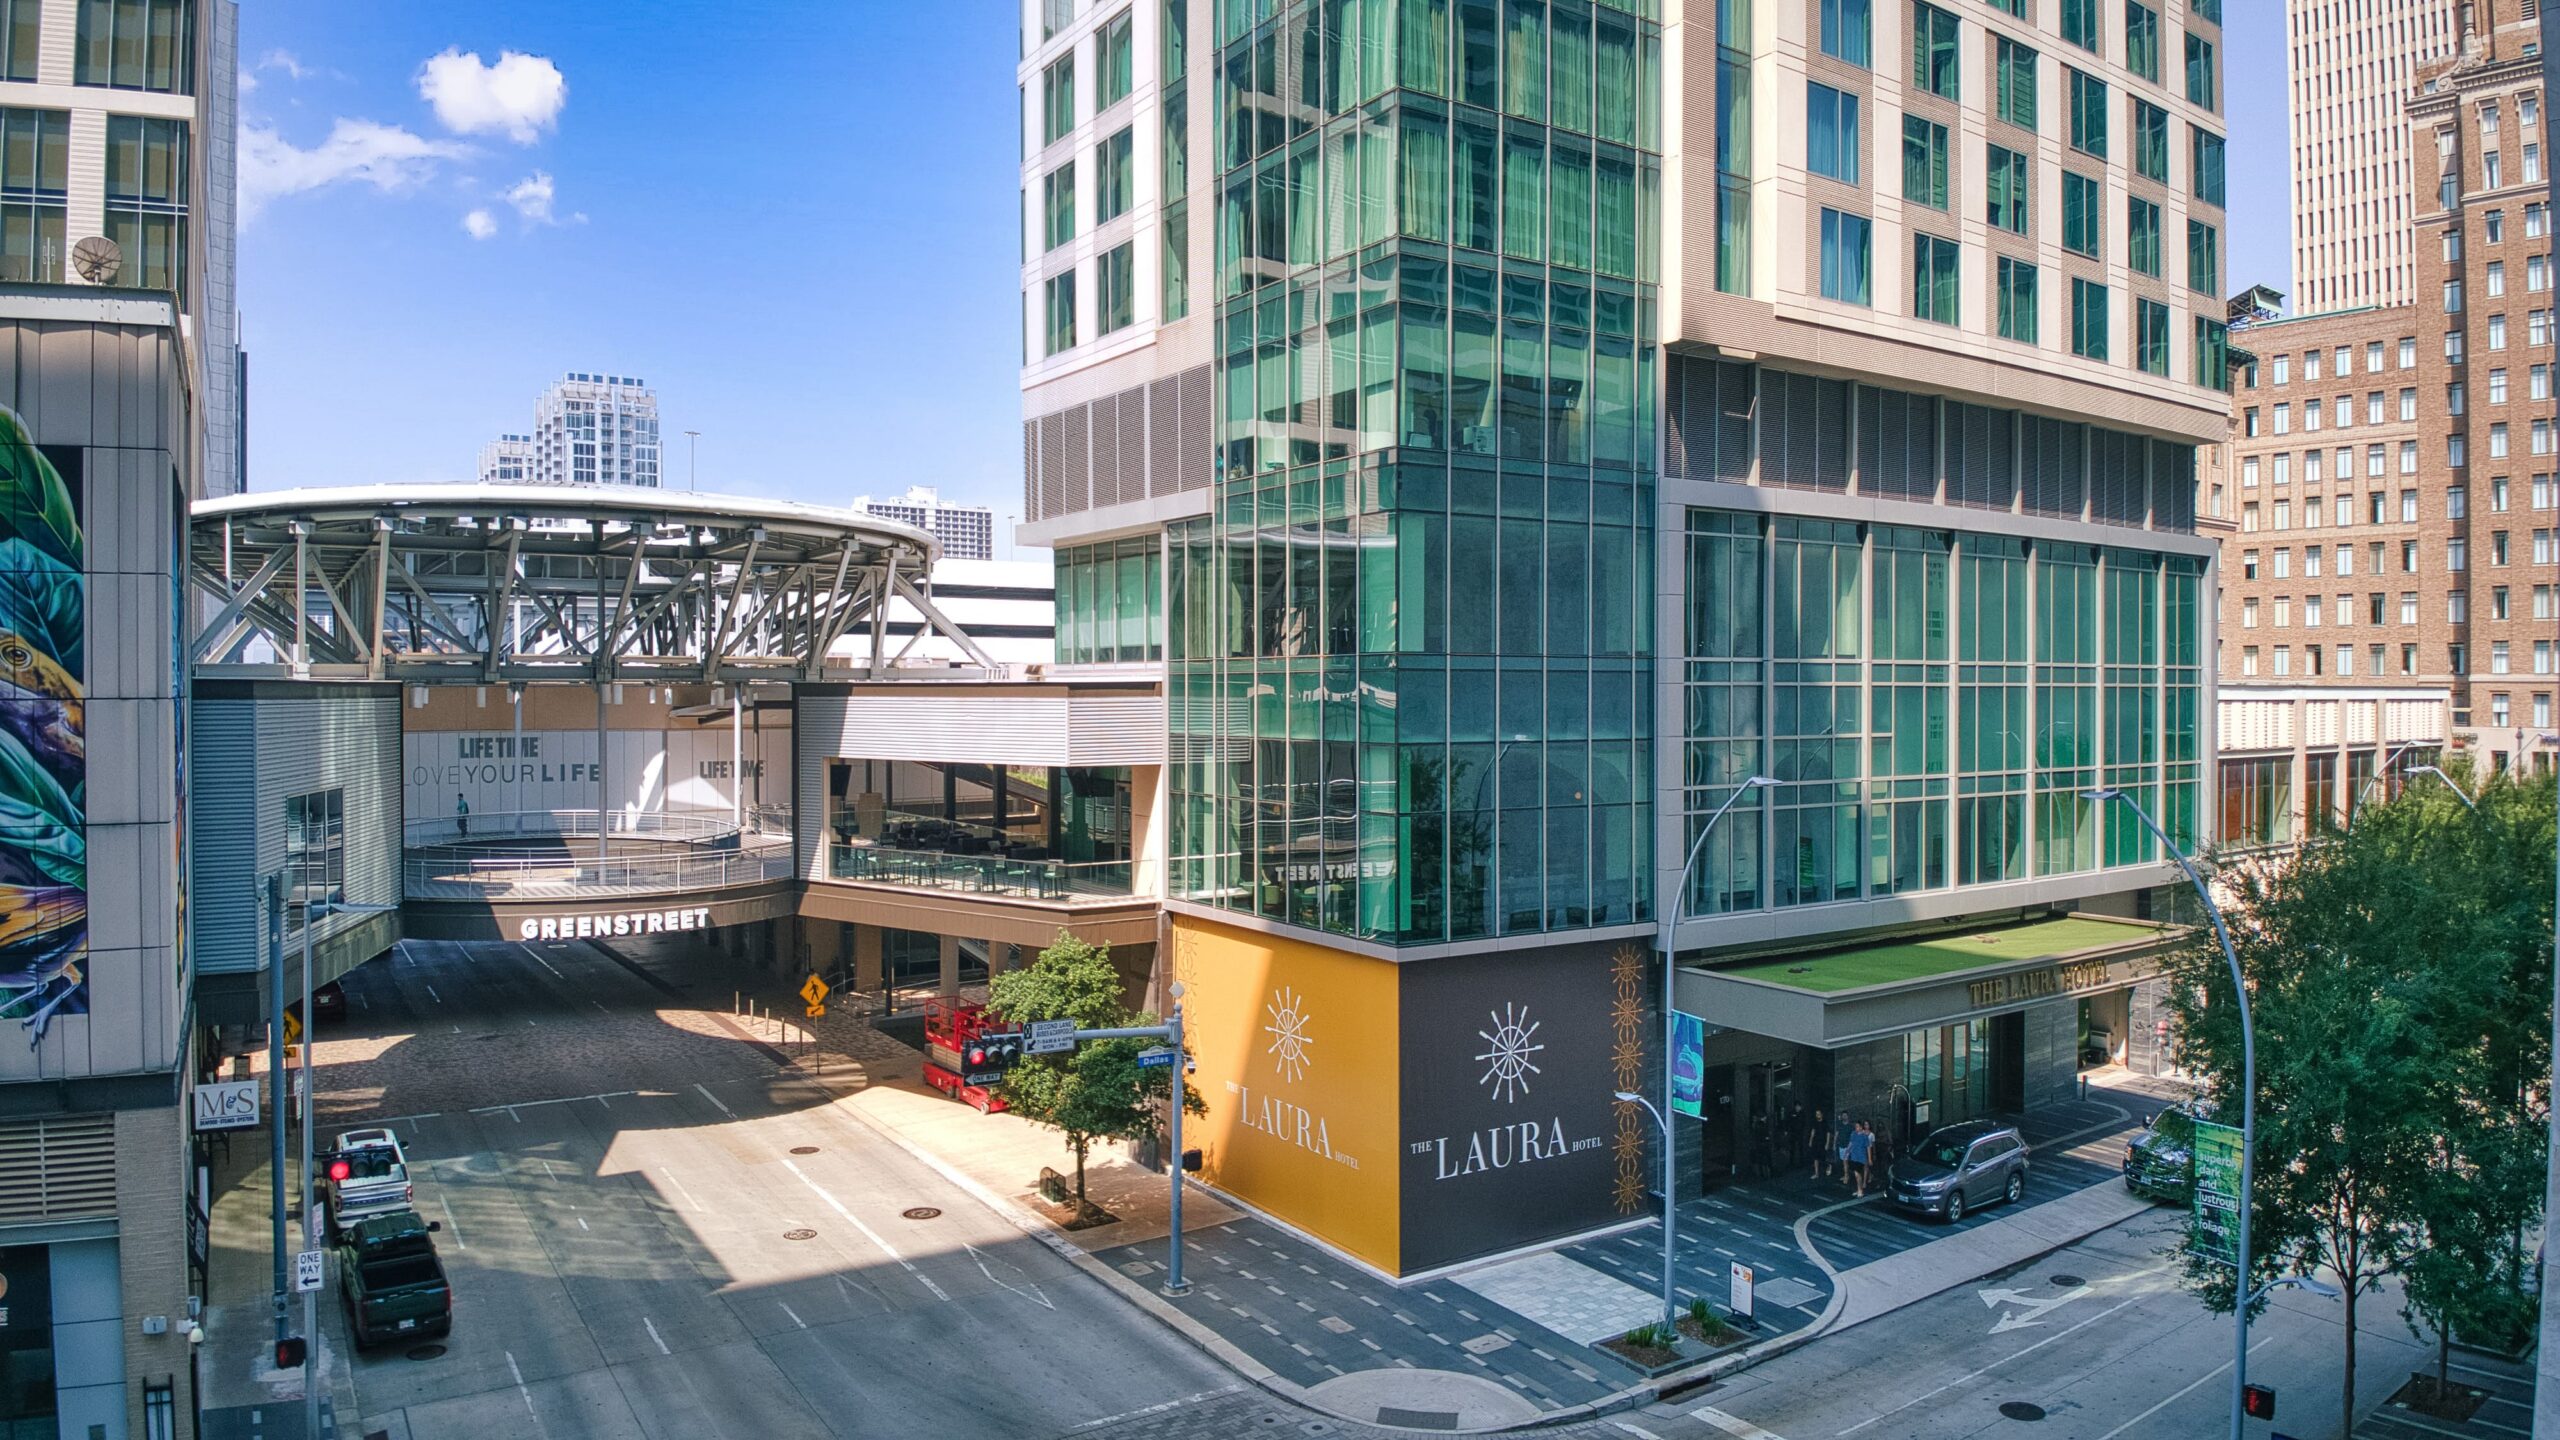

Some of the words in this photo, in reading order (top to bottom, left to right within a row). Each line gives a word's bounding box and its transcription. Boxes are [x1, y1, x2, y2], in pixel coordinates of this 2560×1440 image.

[459, 737, 493, 759] LIFE
[403, 765, 460, 787] OVE
[464, 764, 534, 784] YOUR
[541, 763, 600, 783] LIFE
[699, 760, 728, 779] LIFE
[729, 760, 764, 778] TME
[520, 907, 709, 940] GREENSTREET
[1970, 979, 2003, 1006] THE
[2007, 968, 2057, 999] LAURA
[2063, 960, 2111, 992] HOTEL
[1036, 1022, 1058, 1031] SECOND
[1059, 1020, 1072, 1029] LANE
[1143, 1056, 1169, 1066] Dallas
[1240, 1086, 1333, 1160] LAURA
[1335, 1151, 1359, 1170] HOTEL
[1410, 1140, 1432, 1154] THE
[1435, 1116, 1570, 1181] LAURA
[1572, 1136, 1603, 1152] HOTEL
[2199, 1164, 2221, 1178] dark
[2198, 1179, 2217, 1190] and
[2198, 1191, 2236, 1209] lustrous
[300, 1252, 320, 1264] ONE
[300, 1264, 321, 1275] WAY
